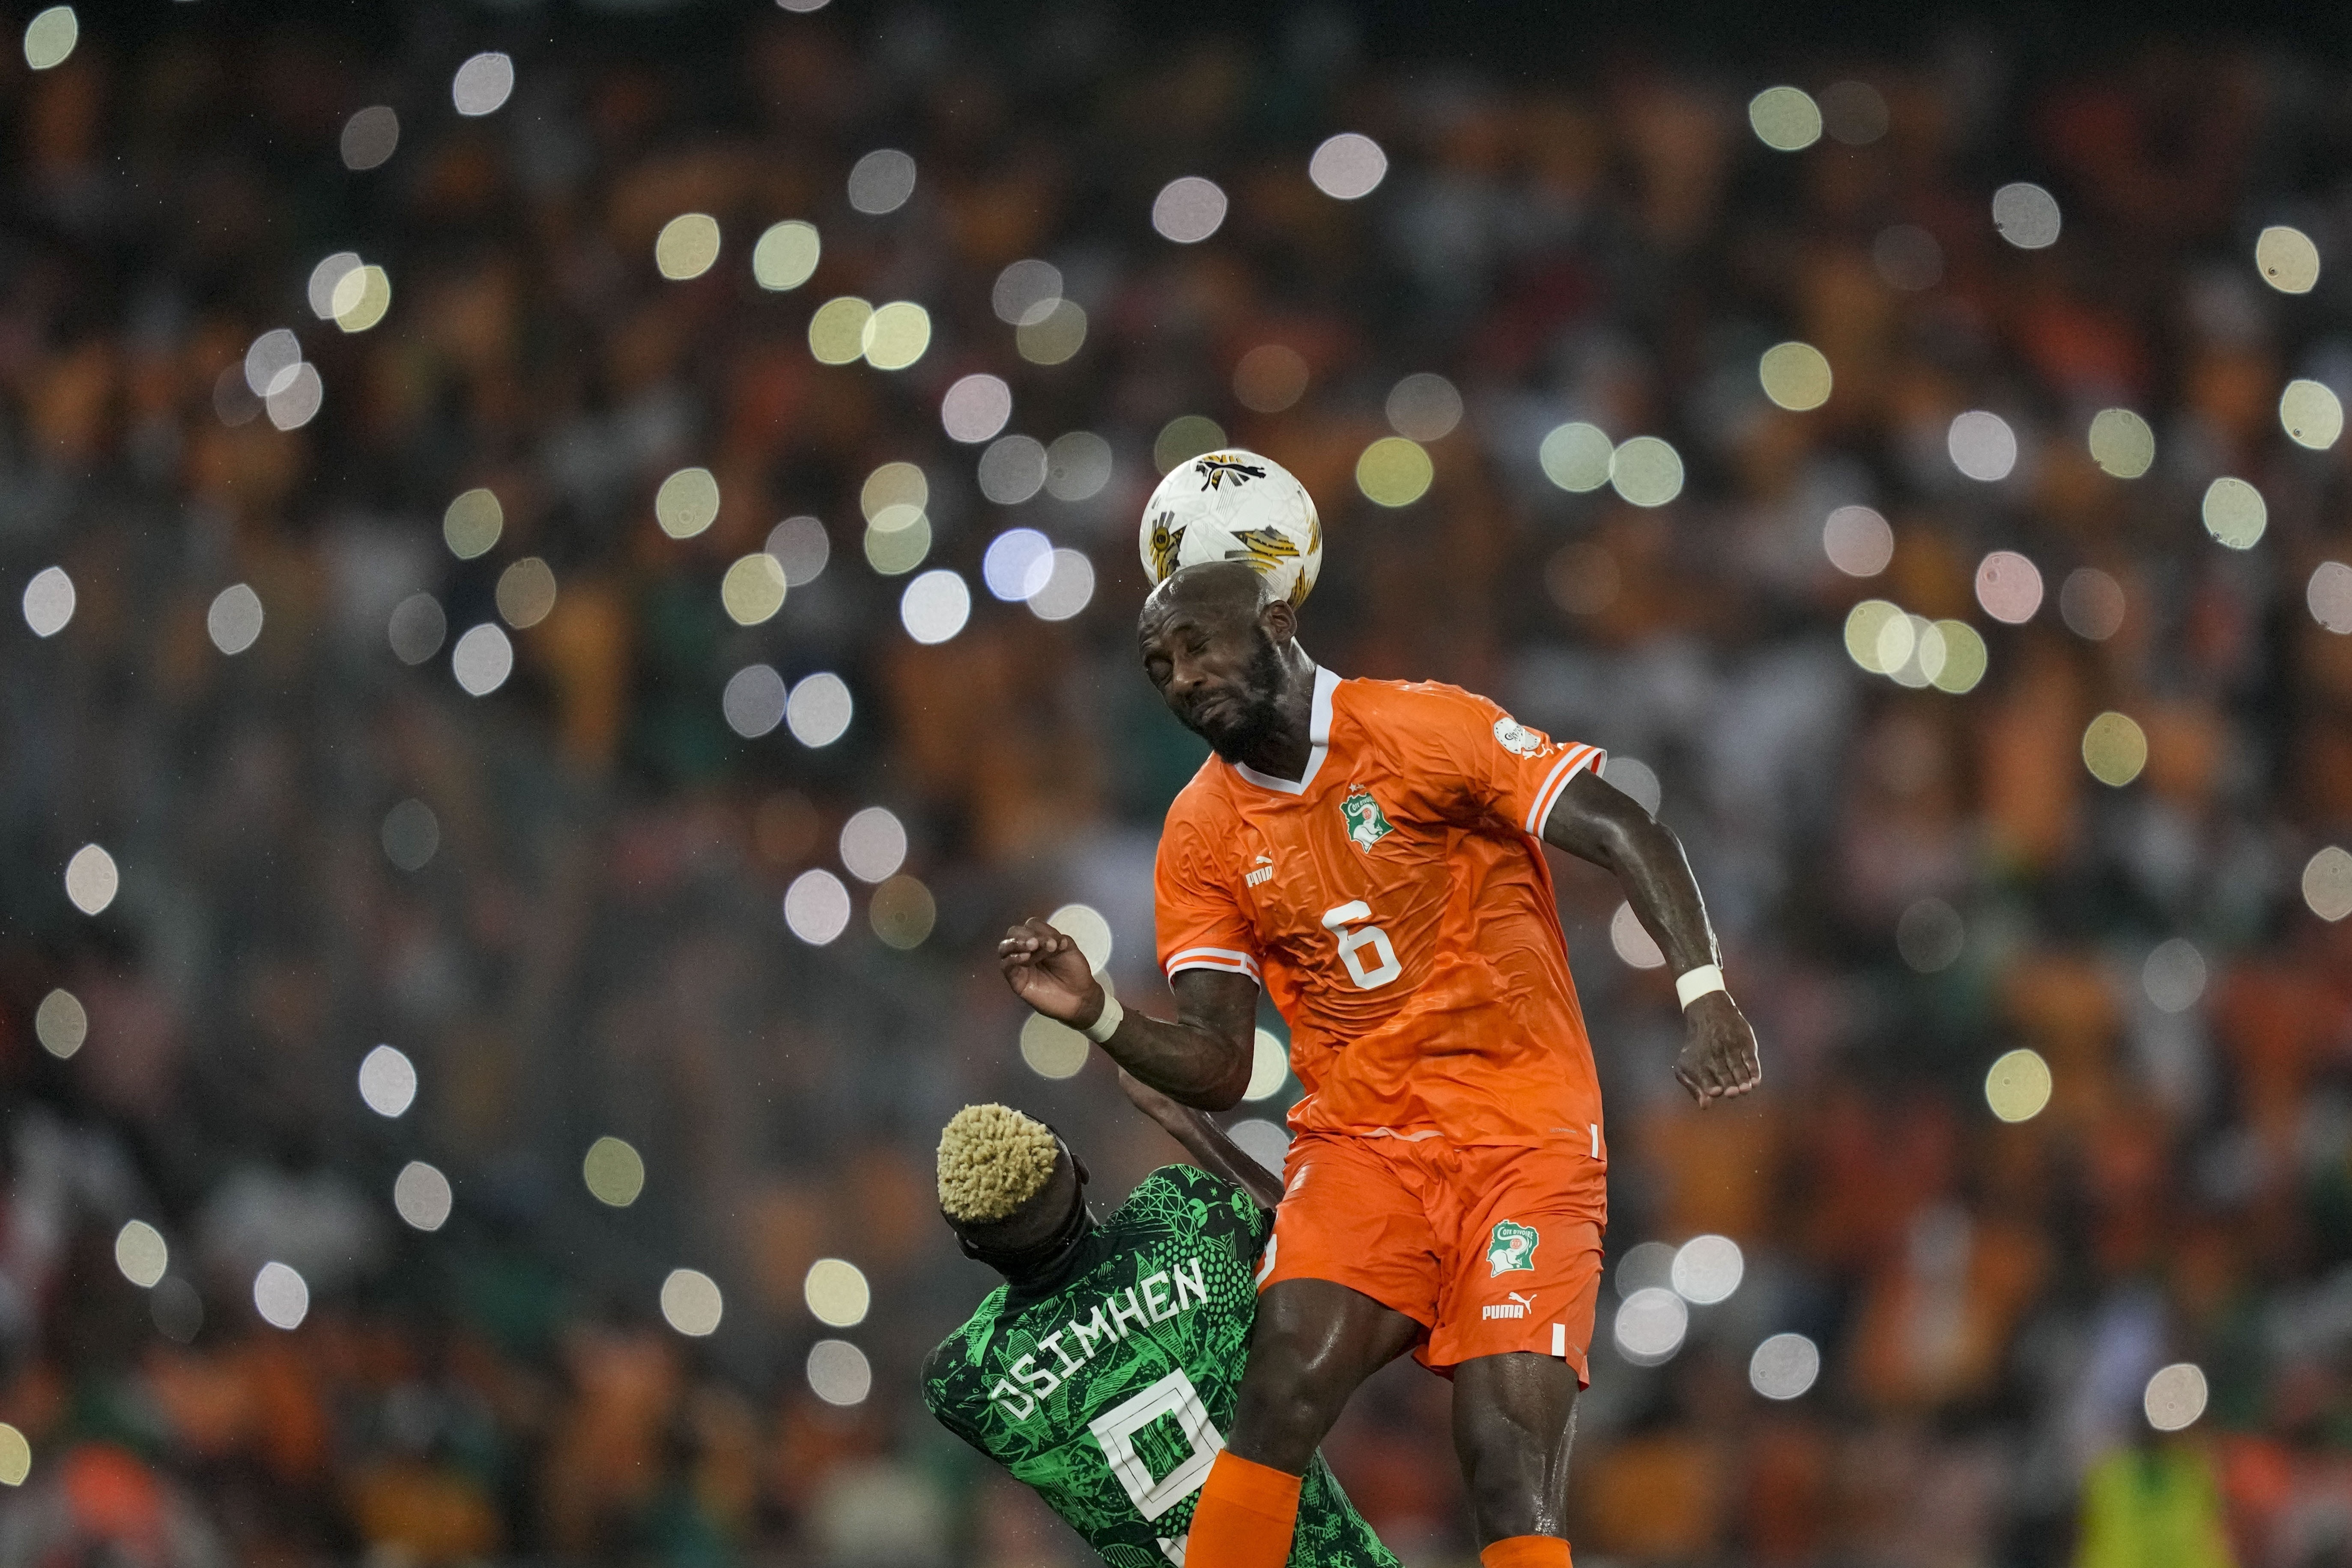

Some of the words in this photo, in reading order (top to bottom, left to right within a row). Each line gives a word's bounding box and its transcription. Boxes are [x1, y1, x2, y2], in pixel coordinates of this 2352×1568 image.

[1322, 900, 1402, 990] 6
[991, 1257, 1209, 1421] OSIMHEN
[1482, 1305, 1524, 1320] PUMA
